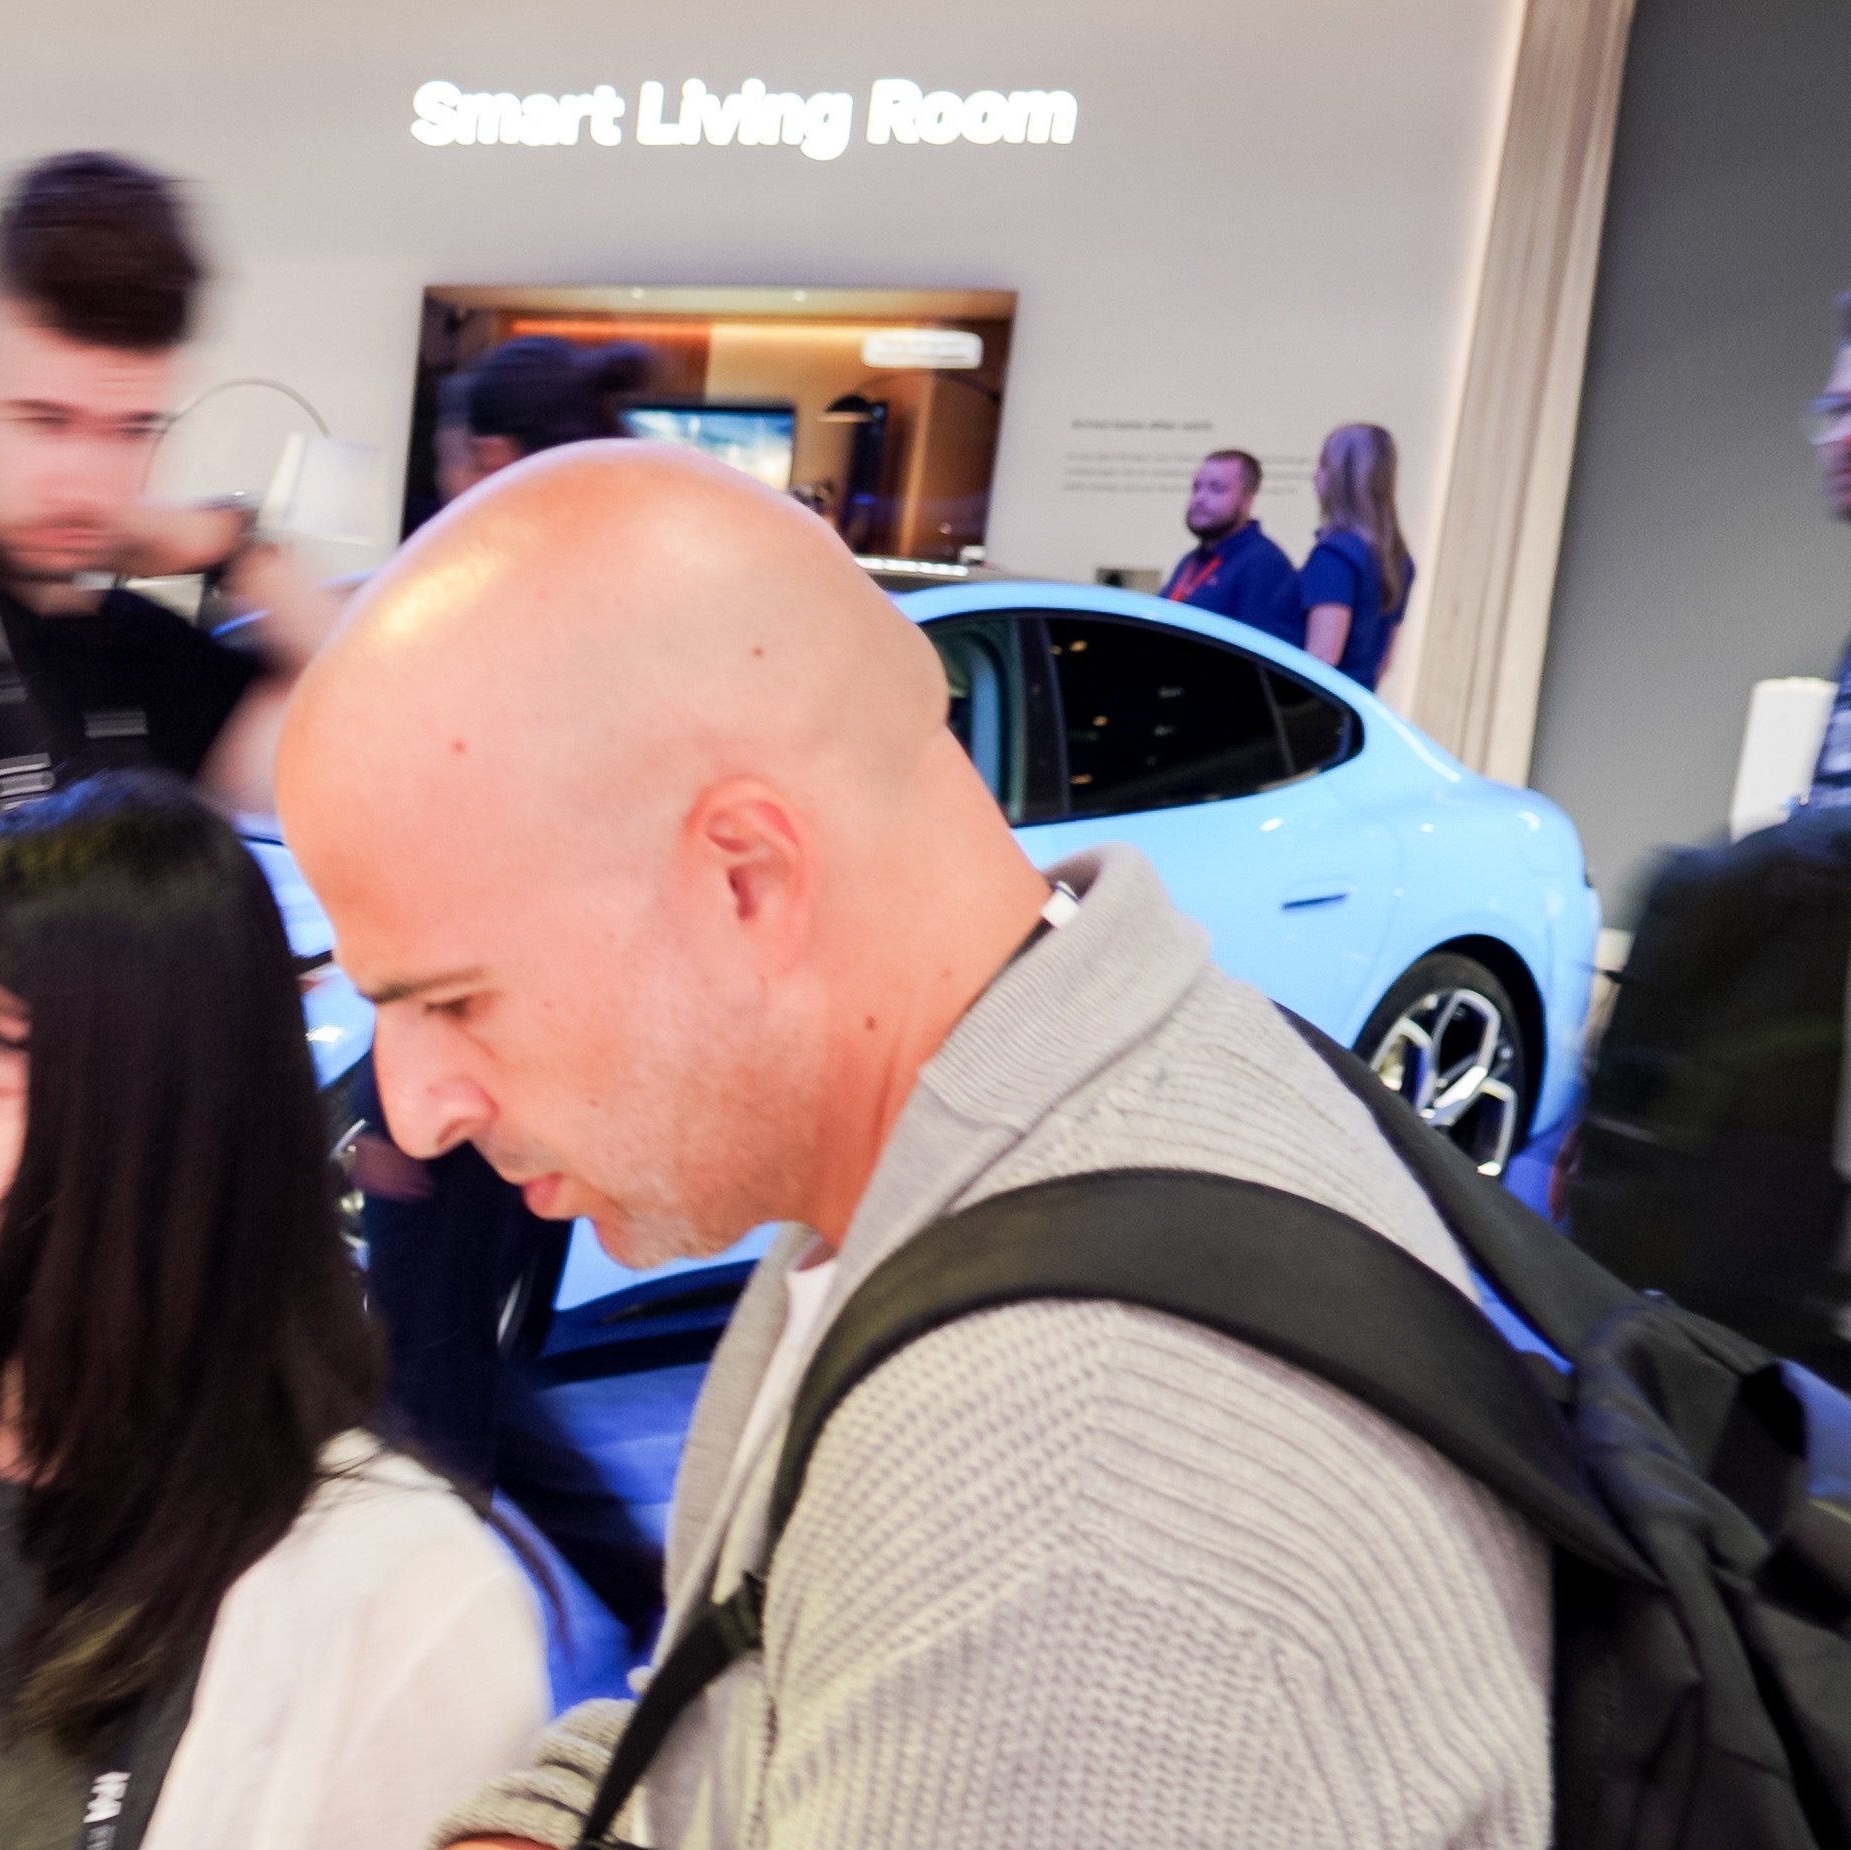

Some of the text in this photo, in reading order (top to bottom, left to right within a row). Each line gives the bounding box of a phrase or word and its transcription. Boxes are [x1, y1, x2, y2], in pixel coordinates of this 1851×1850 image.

[410, 78, 1079, 161] Smart Living Room
